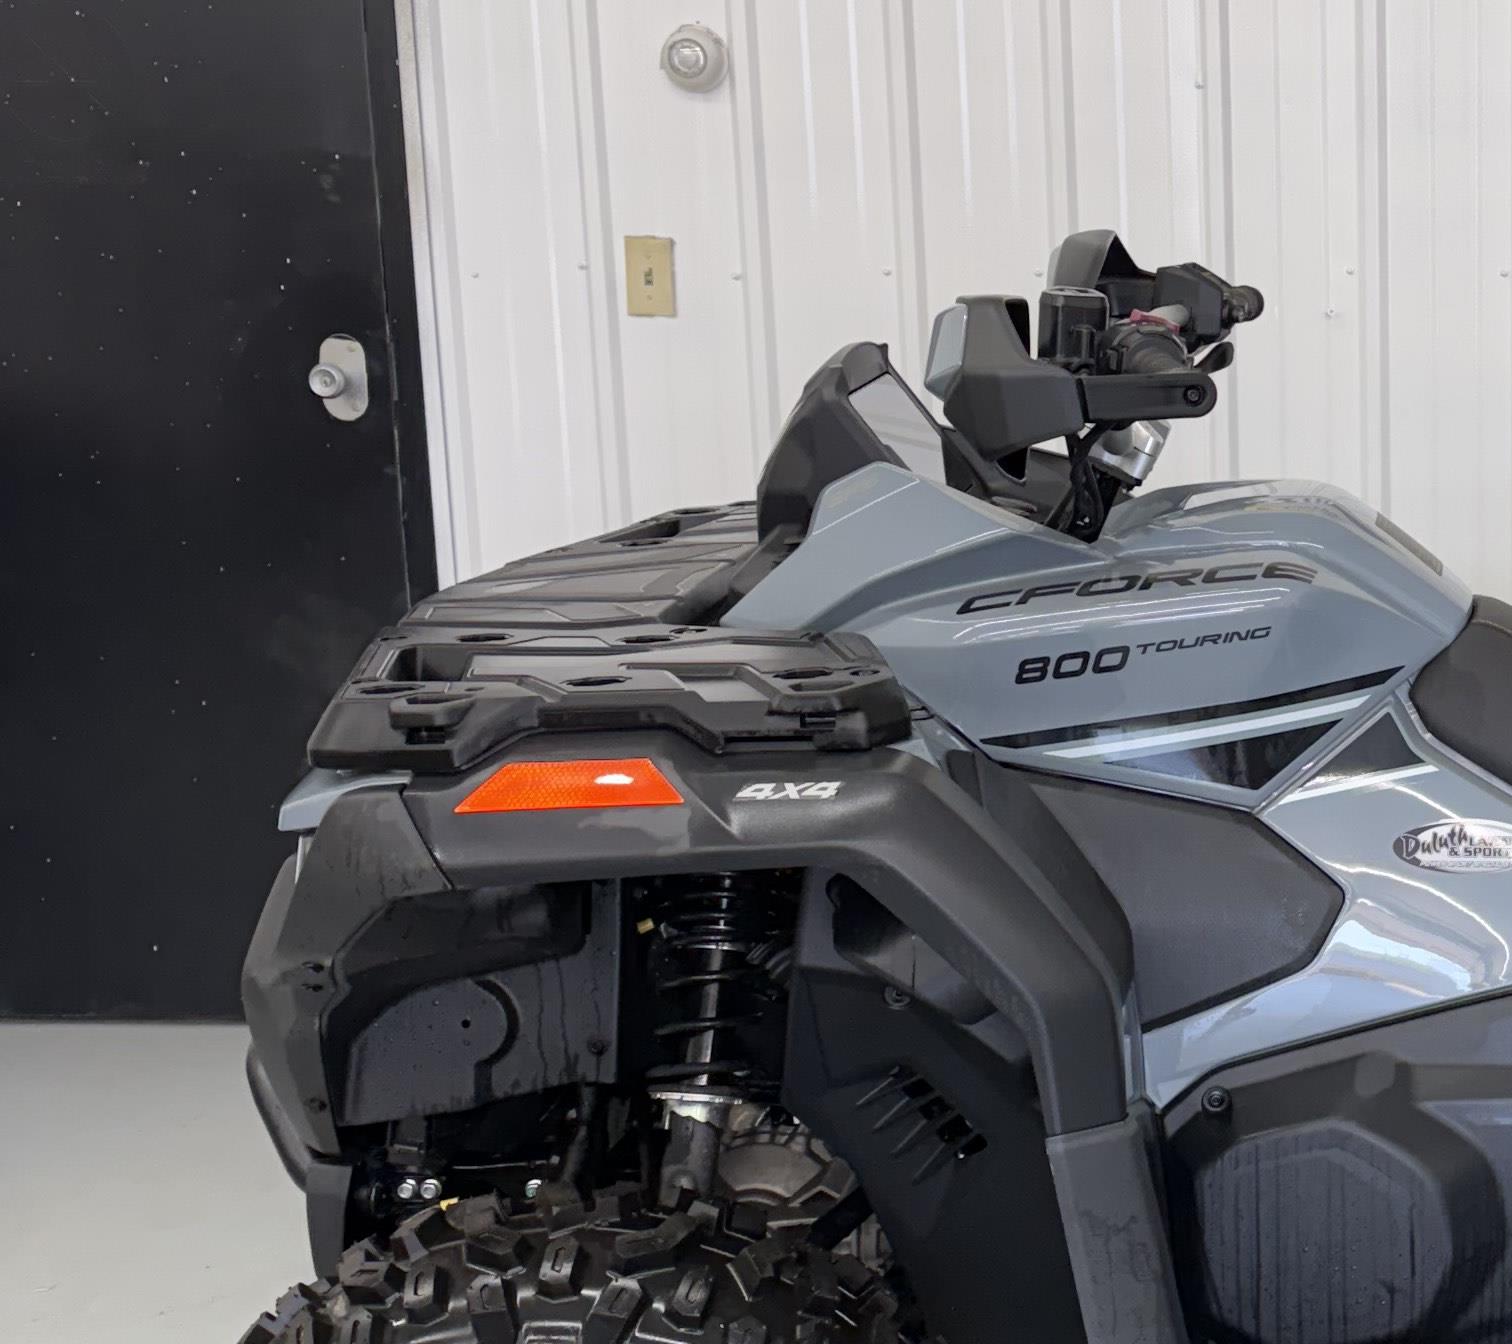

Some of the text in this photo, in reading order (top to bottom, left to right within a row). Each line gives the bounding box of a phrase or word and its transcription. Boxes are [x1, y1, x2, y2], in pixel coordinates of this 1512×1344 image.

[956, 561, 1318, 615] CFORCE
[1014, 625, 1272, 685] 800 TOURING
[1402, 822, 1469, 859] Duluth
[1449, 847, 1460, 858] &
